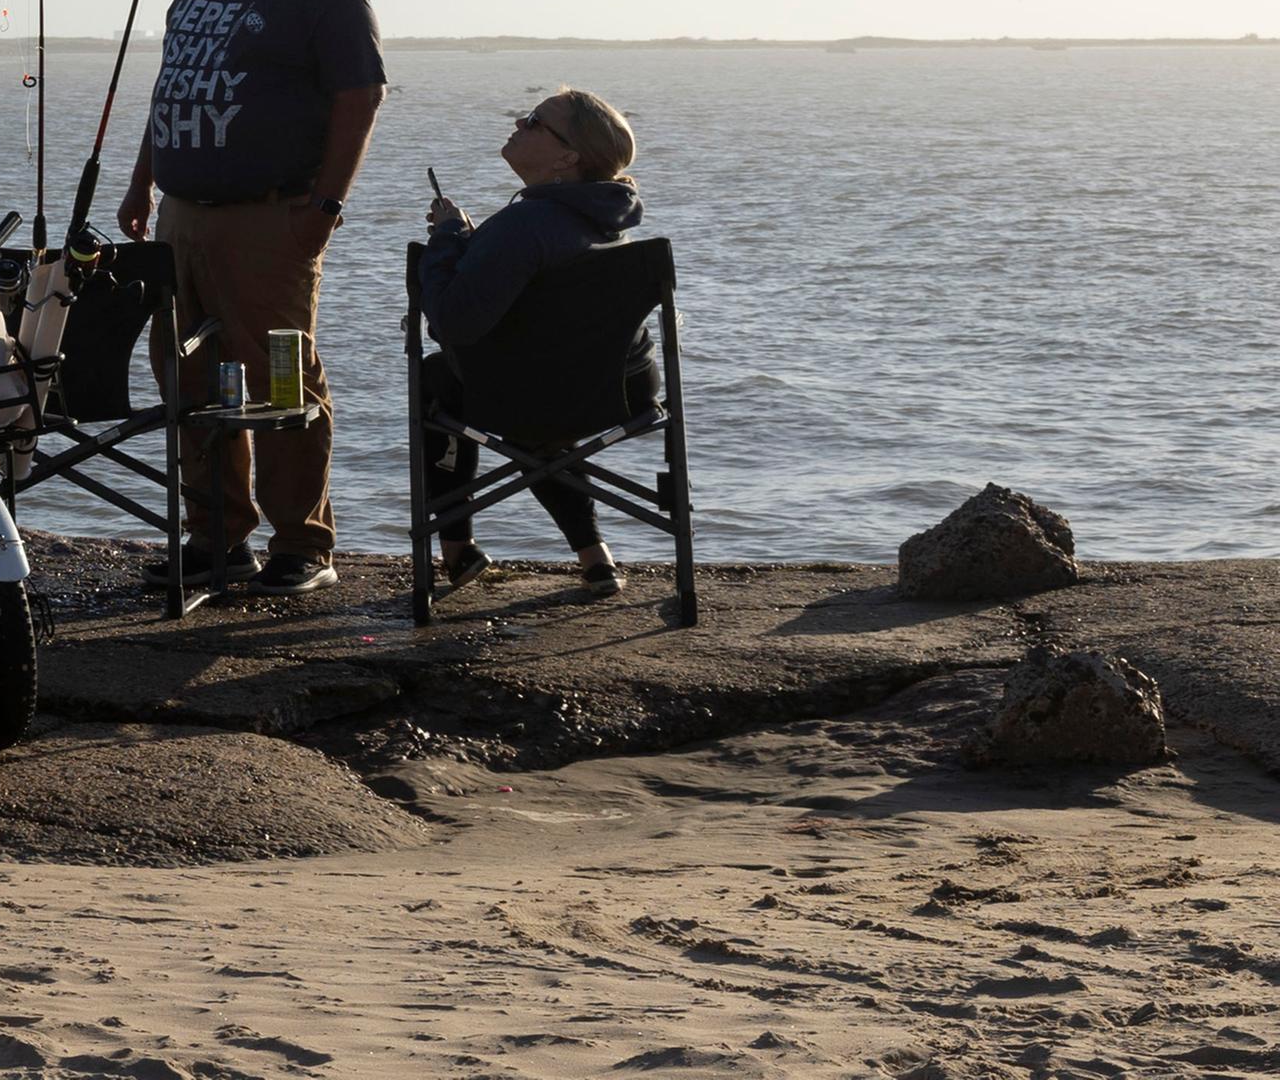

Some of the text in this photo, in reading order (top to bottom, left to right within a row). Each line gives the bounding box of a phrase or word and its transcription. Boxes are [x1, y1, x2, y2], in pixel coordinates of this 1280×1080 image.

[164, 33, 225, 66] ISHY
[154, 67, 248, 102] FISHY
[151, 102, 243, 149] SHY
